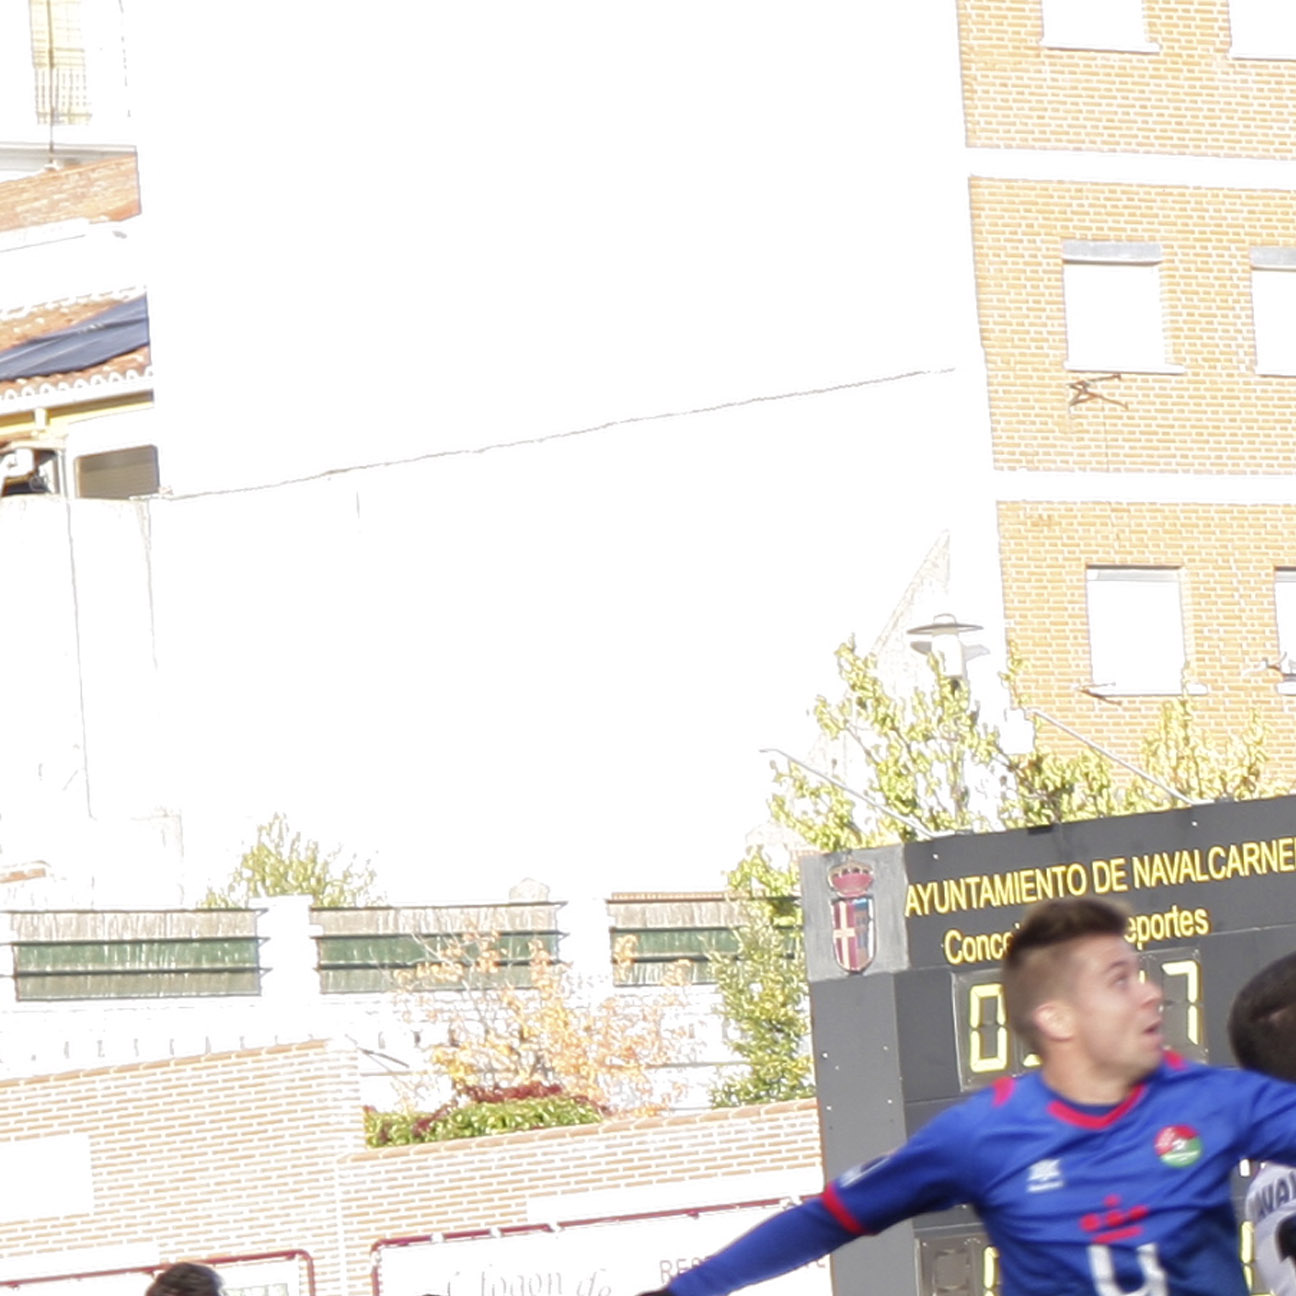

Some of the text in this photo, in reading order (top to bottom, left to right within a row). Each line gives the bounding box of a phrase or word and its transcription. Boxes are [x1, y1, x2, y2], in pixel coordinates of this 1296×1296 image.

[904, 862, 1088, 918] AYUNTAMIENTO
[1092, 857, 1129, 894] DE
[1124, 905, 1210, 951] eportes
